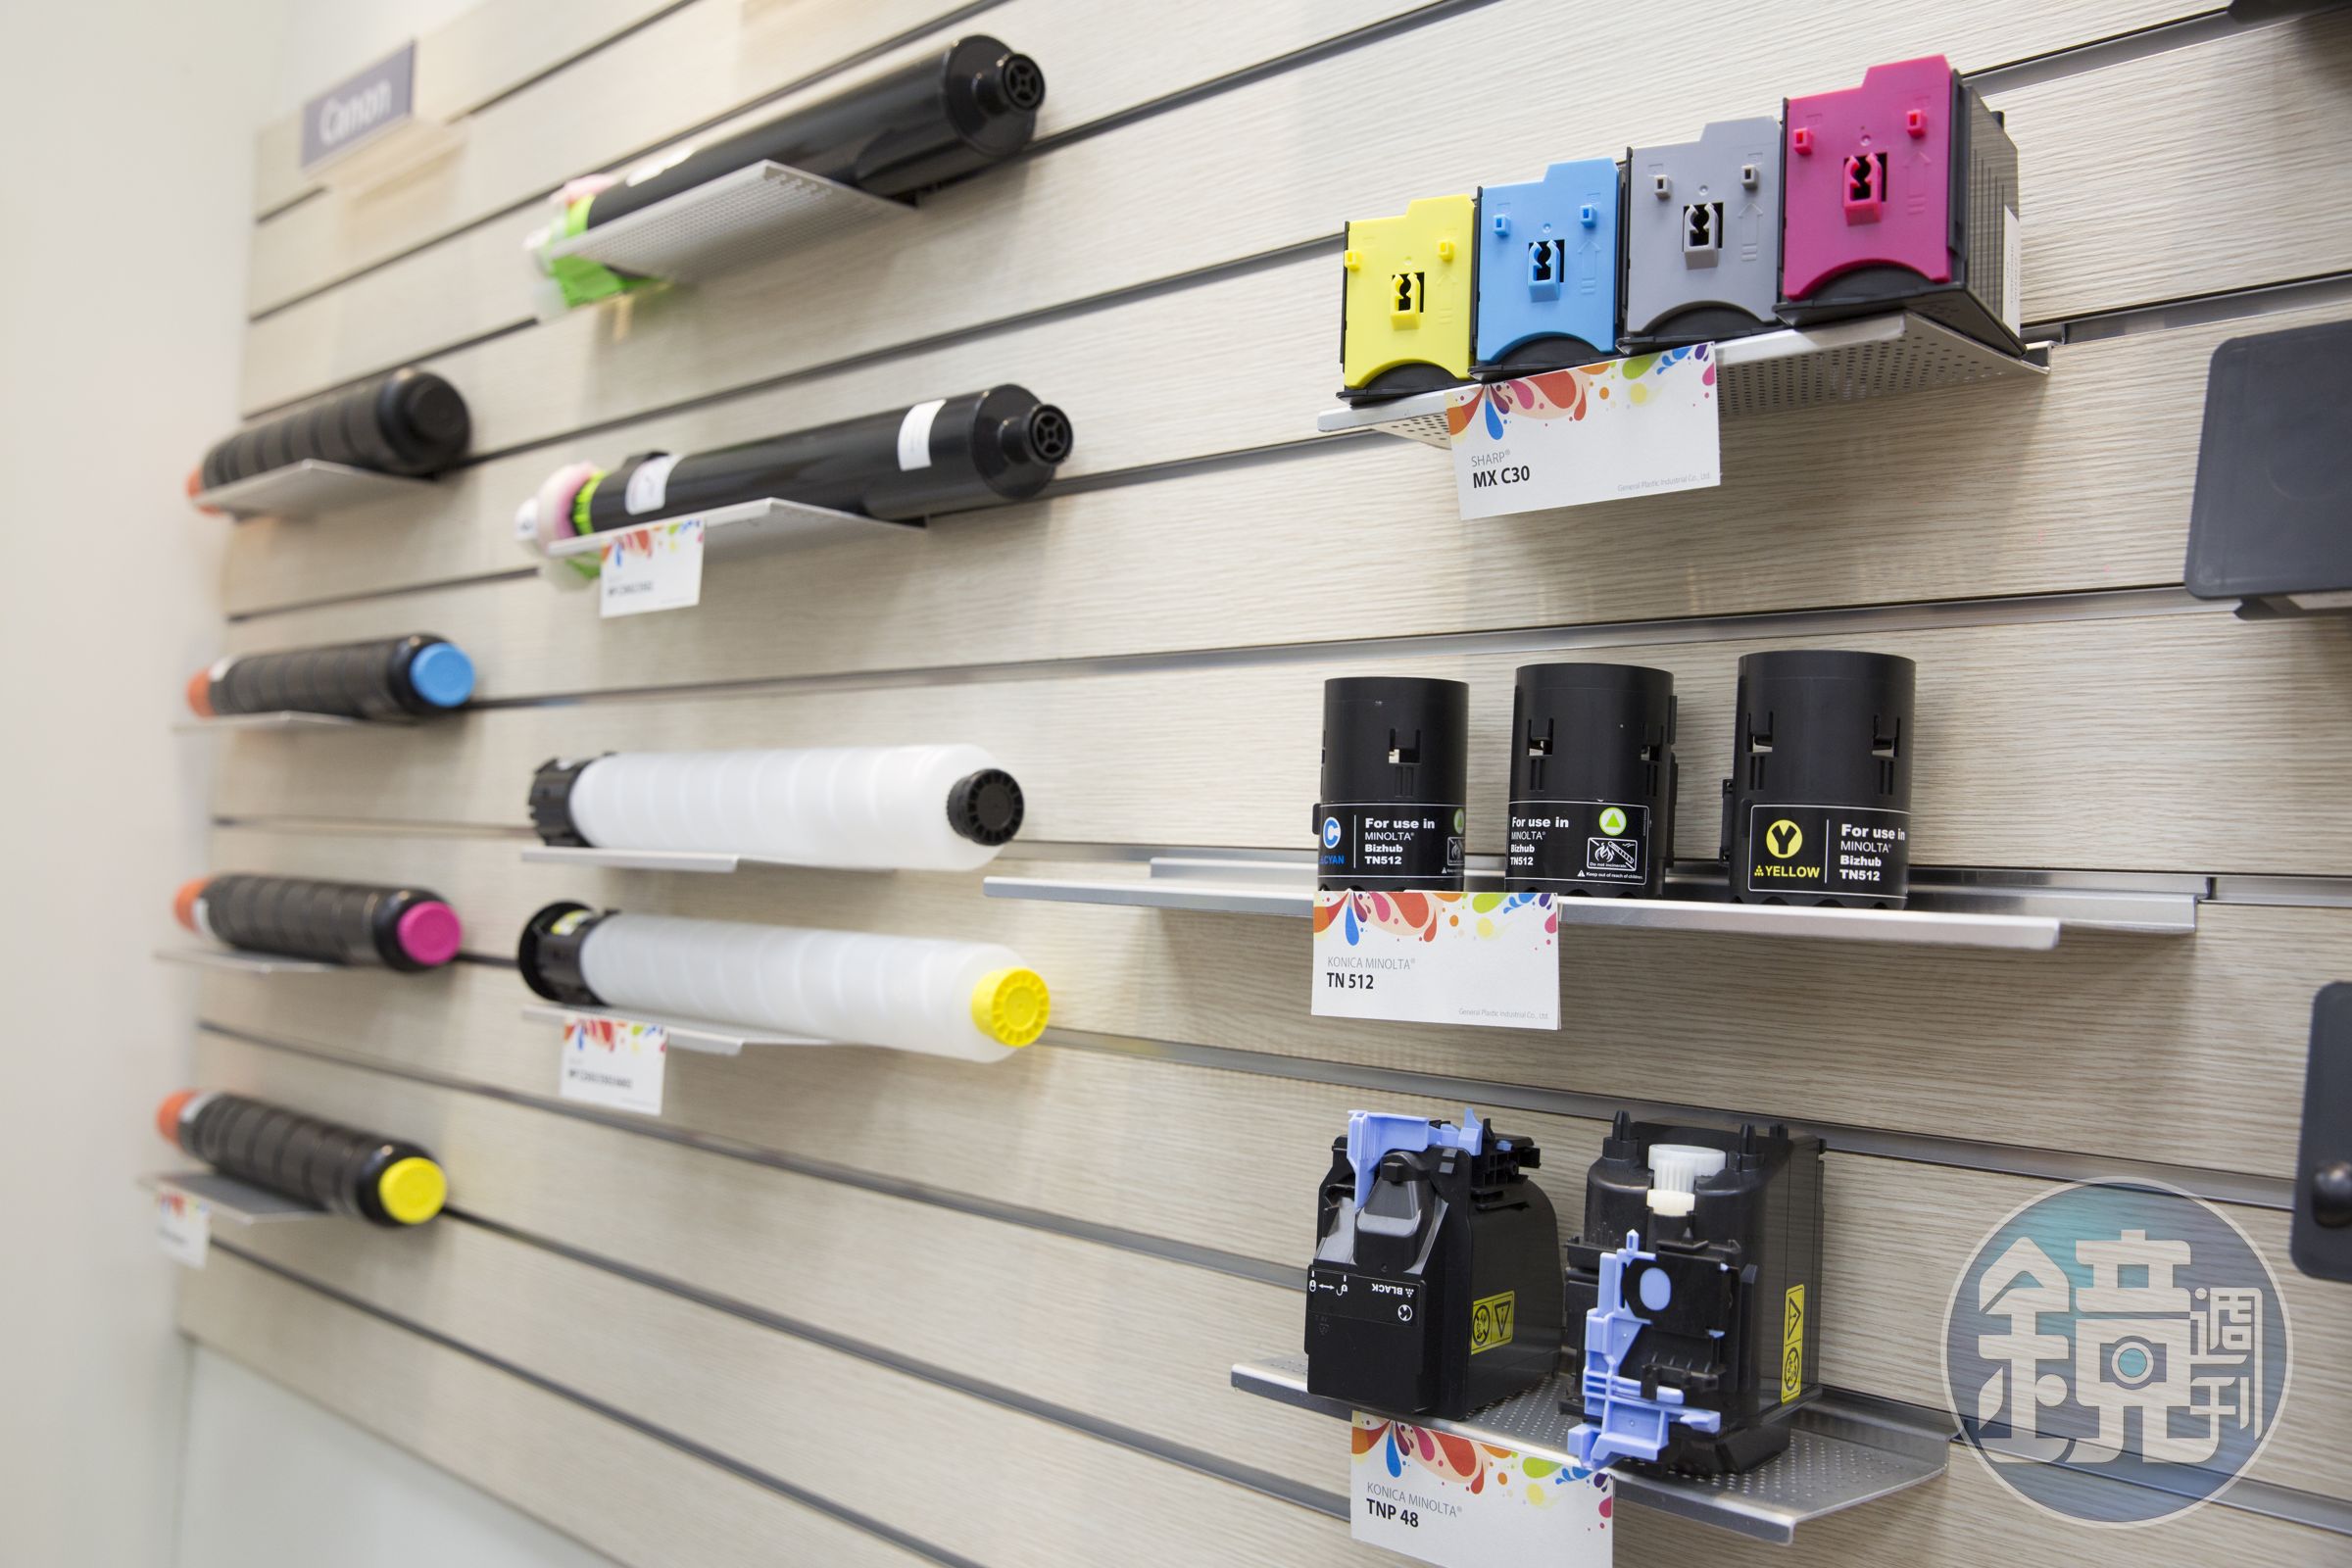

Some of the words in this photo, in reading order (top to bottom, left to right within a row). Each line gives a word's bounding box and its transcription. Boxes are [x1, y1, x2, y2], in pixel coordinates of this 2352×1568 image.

[318, 78, 391, 146] Canon
[1473, 469, 1497, 489] MX
[1501, 466, 1530, 484] C30
[1364, 817, 1390, 829] For
[1393, 819, 1419, 829] use
[1423, 817, 1436, 829] in
[1511, 816, 1525, 828] For
[1528, 817, 1551, 828] use
[1554, 816, 1569, 828] in
[1840, 823, 1870, 838] For
[1873, 827, 1895, 840] use
[1897, 828, 1906, 841] in
[1770, 824, 1798, 855] Y
[1364, 844, 1403, 853] Bizhub
[1510, 844, 1536, 853] Bizhub
[1323, 855, 1345, 864] CYAN
[1364, 856, 1402, 865] TN512
[1510, 857, 1534, 866] TN512
[1839, 855, 1882, 867] Bizhub
[1765, 865, 1821, 878] YELLOW
[1839, 868, 1881, 881] TN512
[1327, 956, 1363, 968] KONICA
[1326, 972, 1345, 989] TN
[1348, 973, 1374, 990] 512
[1372, 1283, 1403, 1296] BLACK
[1367, 1481, 1406, 1502] KONICA
[1366, 1497, 1396, 1520] TNP
[1399, 1509, 1419, 1528] 48
